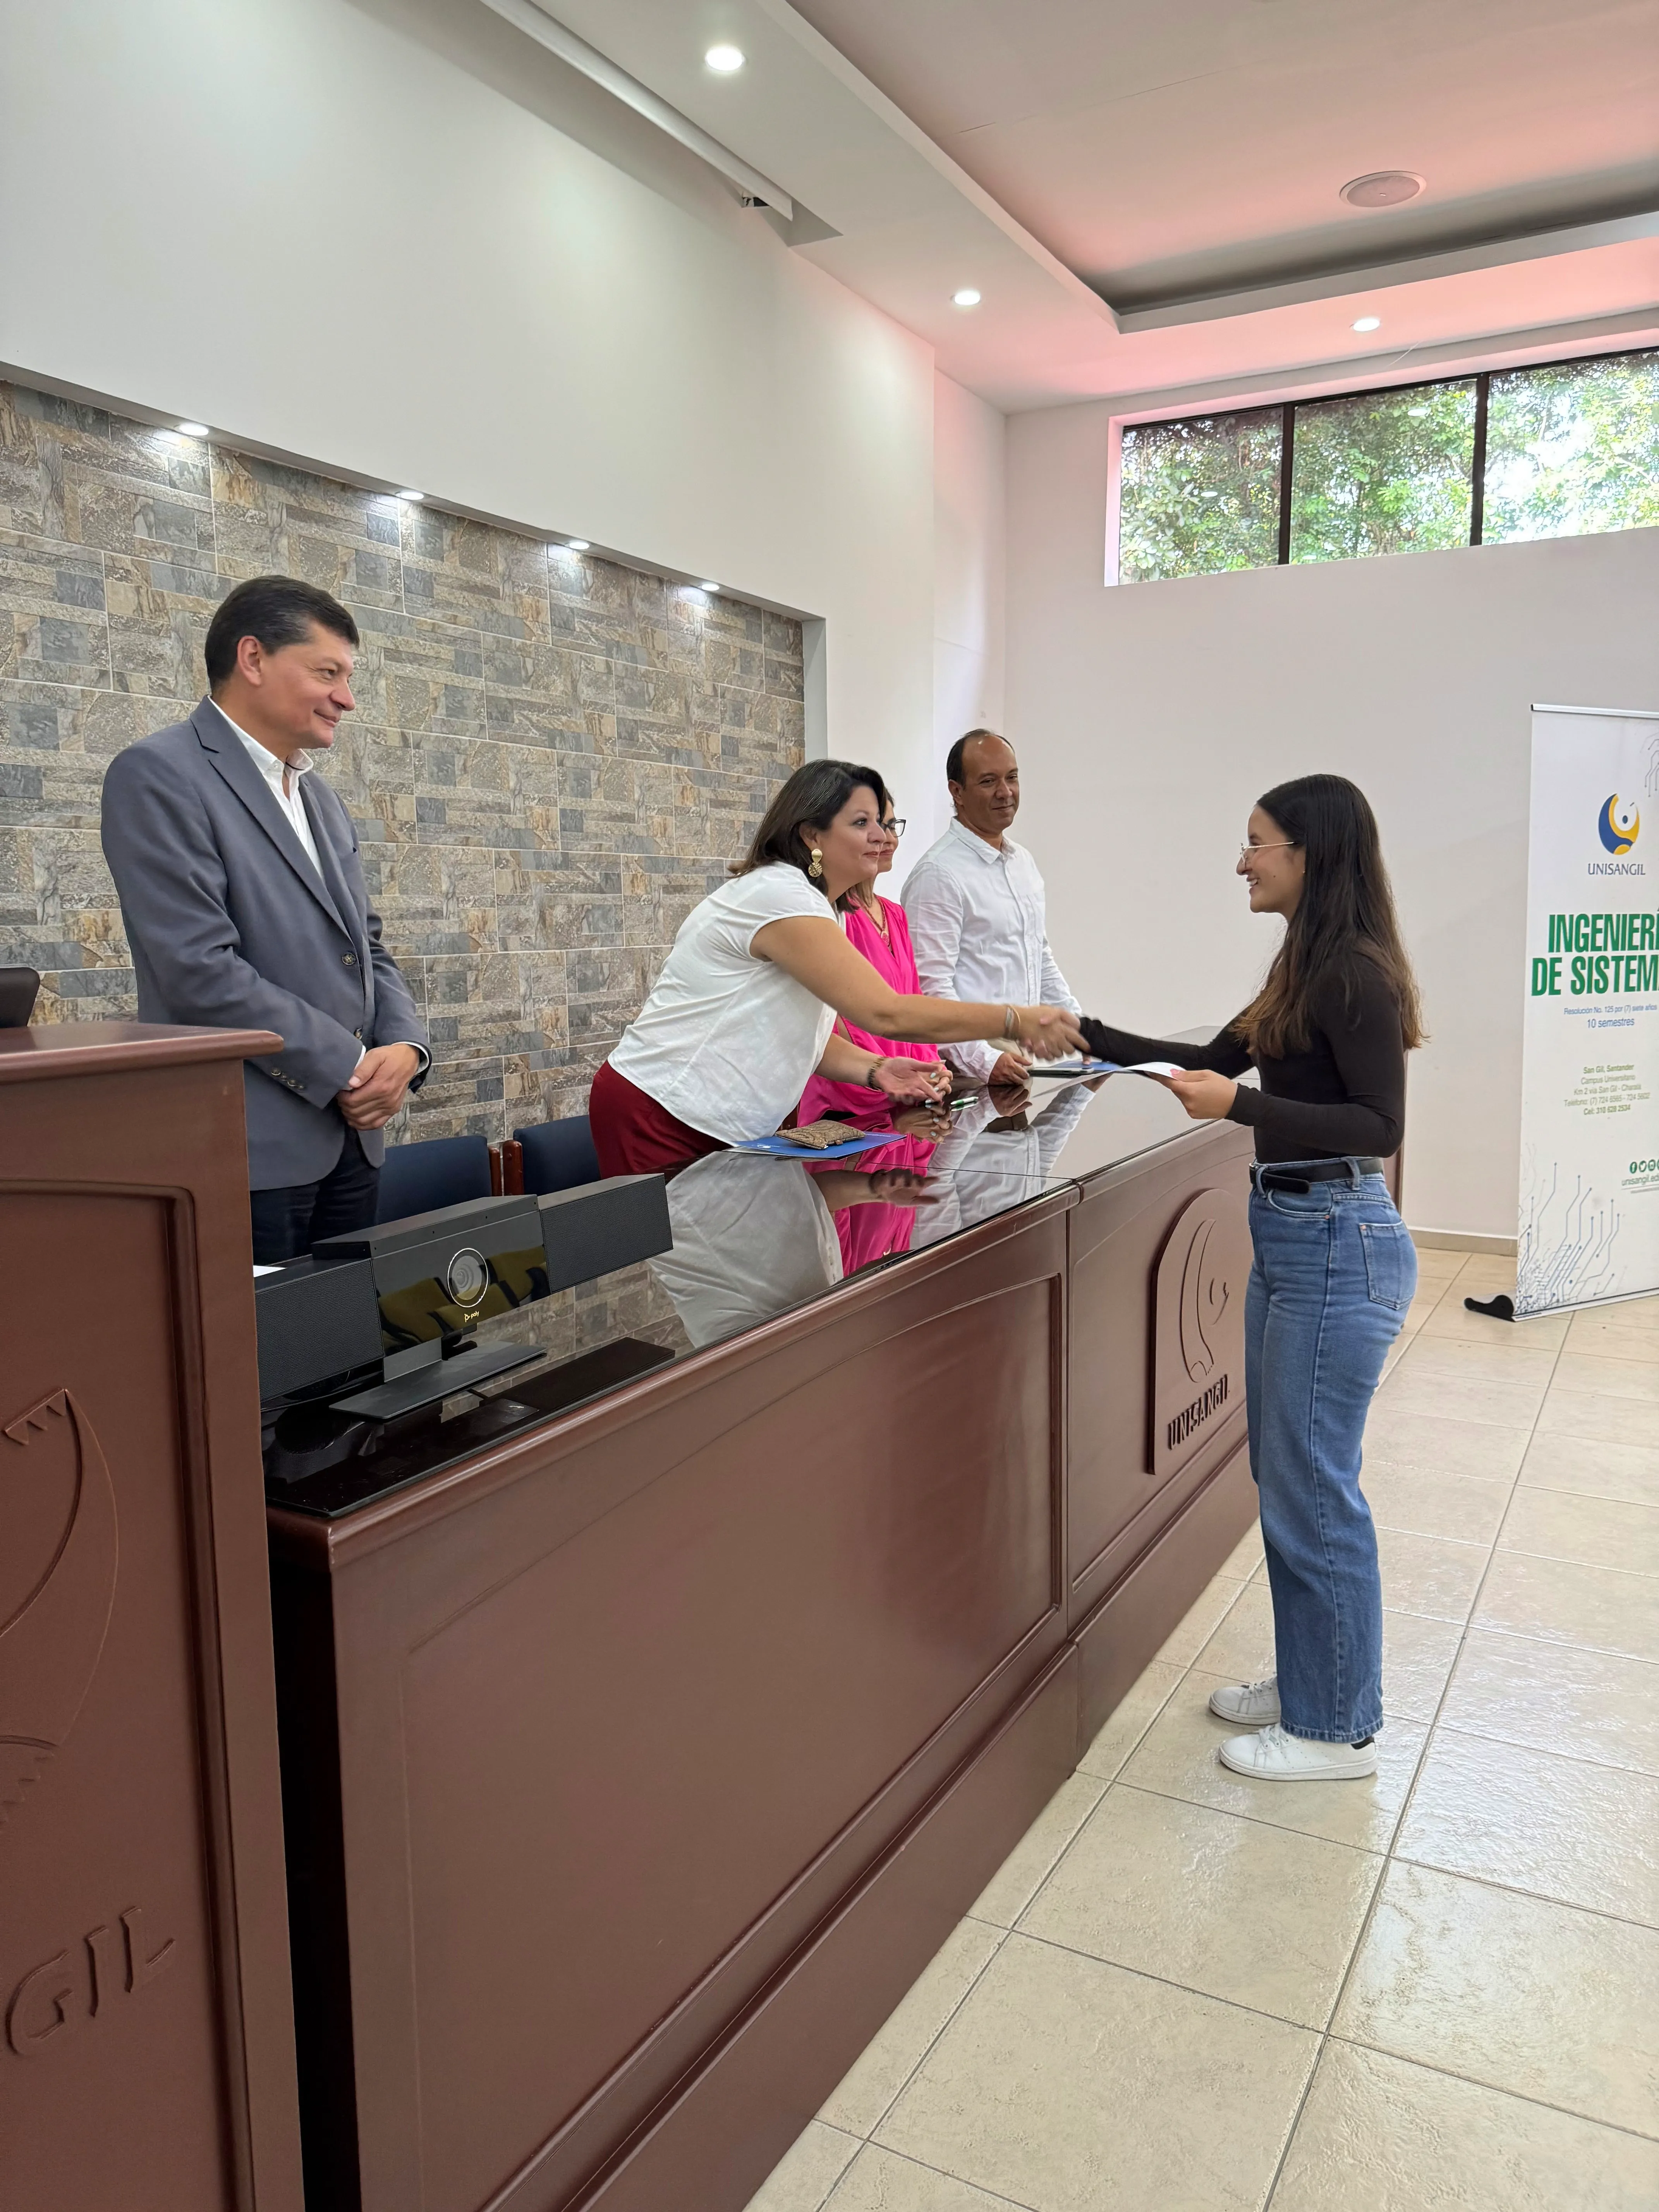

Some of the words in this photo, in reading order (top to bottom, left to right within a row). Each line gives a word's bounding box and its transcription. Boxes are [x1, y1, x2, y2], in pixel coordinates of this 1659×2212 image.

[1588, 863, 1645, 875] UNISANGIL
[1532, 957, 1562, 996] DE
[1570, 955, 1659, 995] SISTEM
[1587, 1018, 1596, 1028] 10
[1598, 1018, 1635, 1027] semestres
[1581, 1077, 1603, 1085] Campus
[1604, 1075, 1635, 1083] Universitario
[471, 1310, 479, 1319] poly
[1167, 1374, 1230, 1450] UNISANGIL
